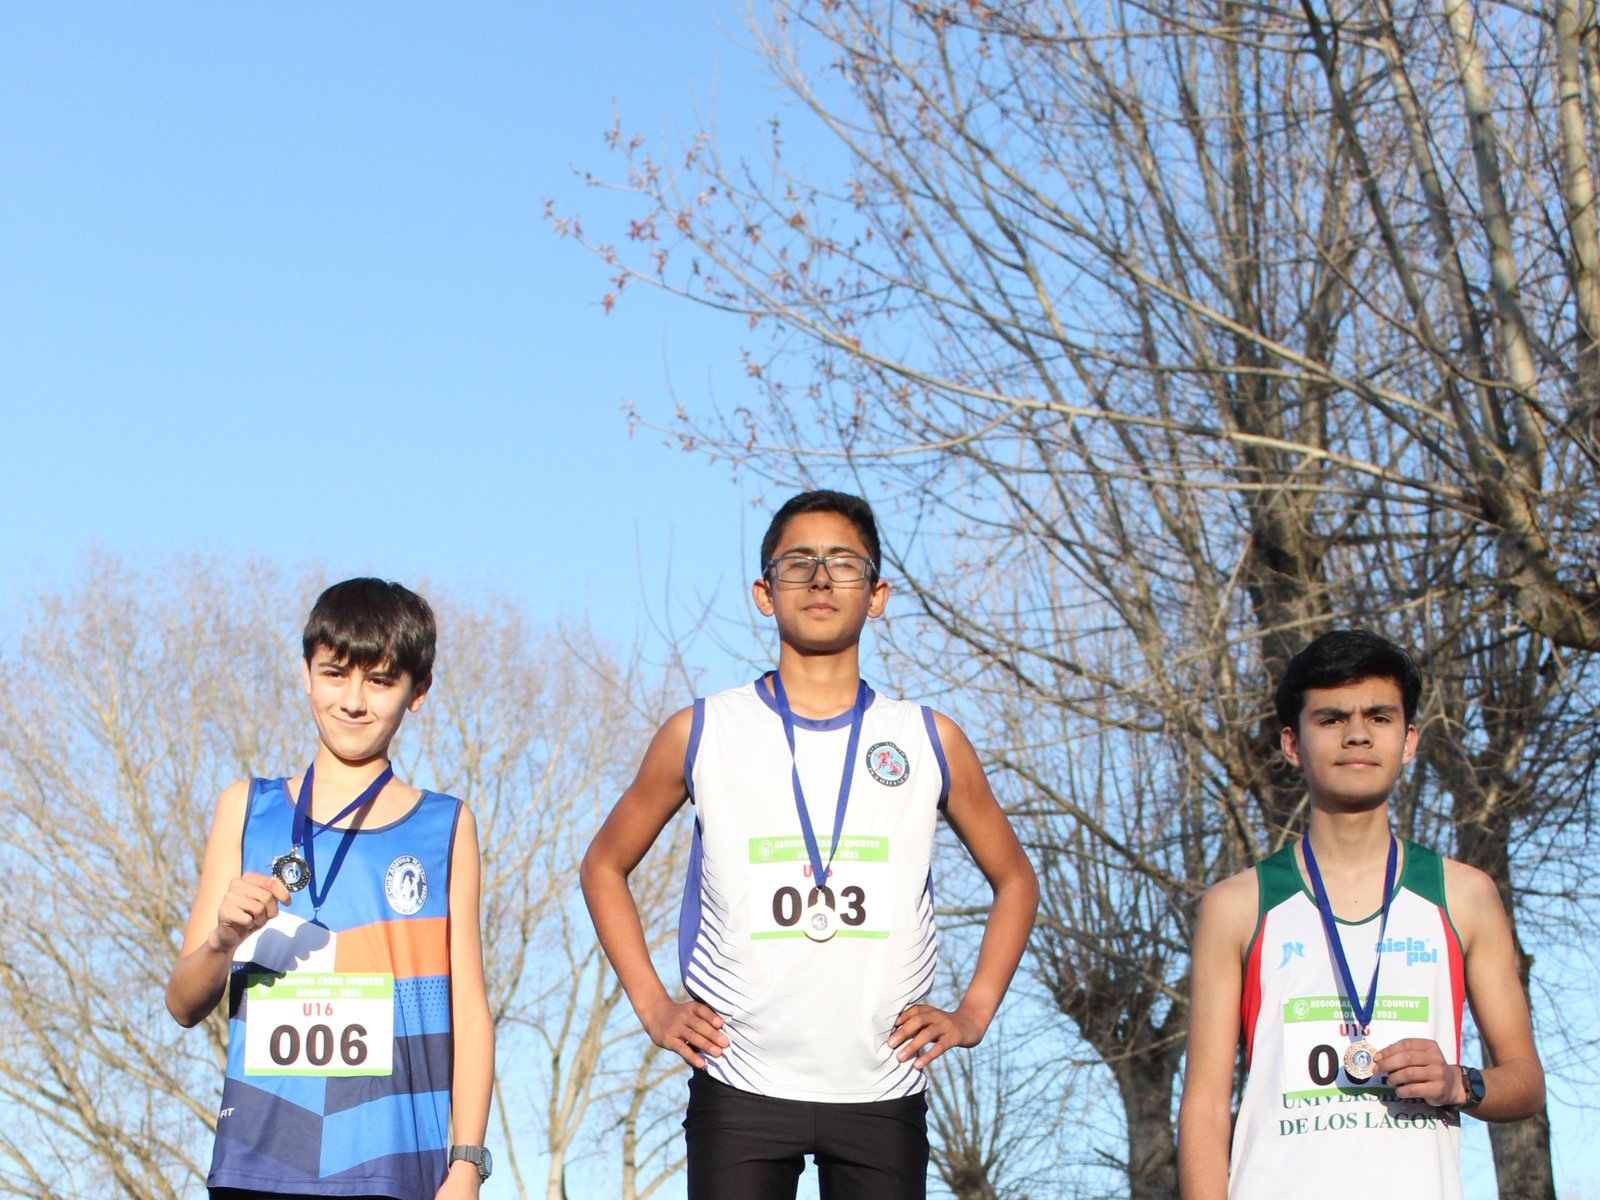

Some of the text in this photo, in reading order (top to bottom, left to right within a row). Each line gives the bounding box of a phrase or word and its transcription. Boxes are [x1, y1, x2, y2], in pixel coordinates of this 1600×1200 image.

[774, 839, 806, 849] REGION
[844, 839, 880, 849] COUNTRY
[797, 850, 829, 860] OSNO
[1375, 937, 1425, 952] aisla
[1406, 948, 1437, 967] pol
[303, 1002, 334, 1017] U16
[1381, 999, 1420, 1009] COUNTRY
[1333, 1010, 1398, 1019] OSOR 2025
[269, 1023, 368, 1067] 006
[1278, 1112, 1437, 1136] DE LOS LAGOS
